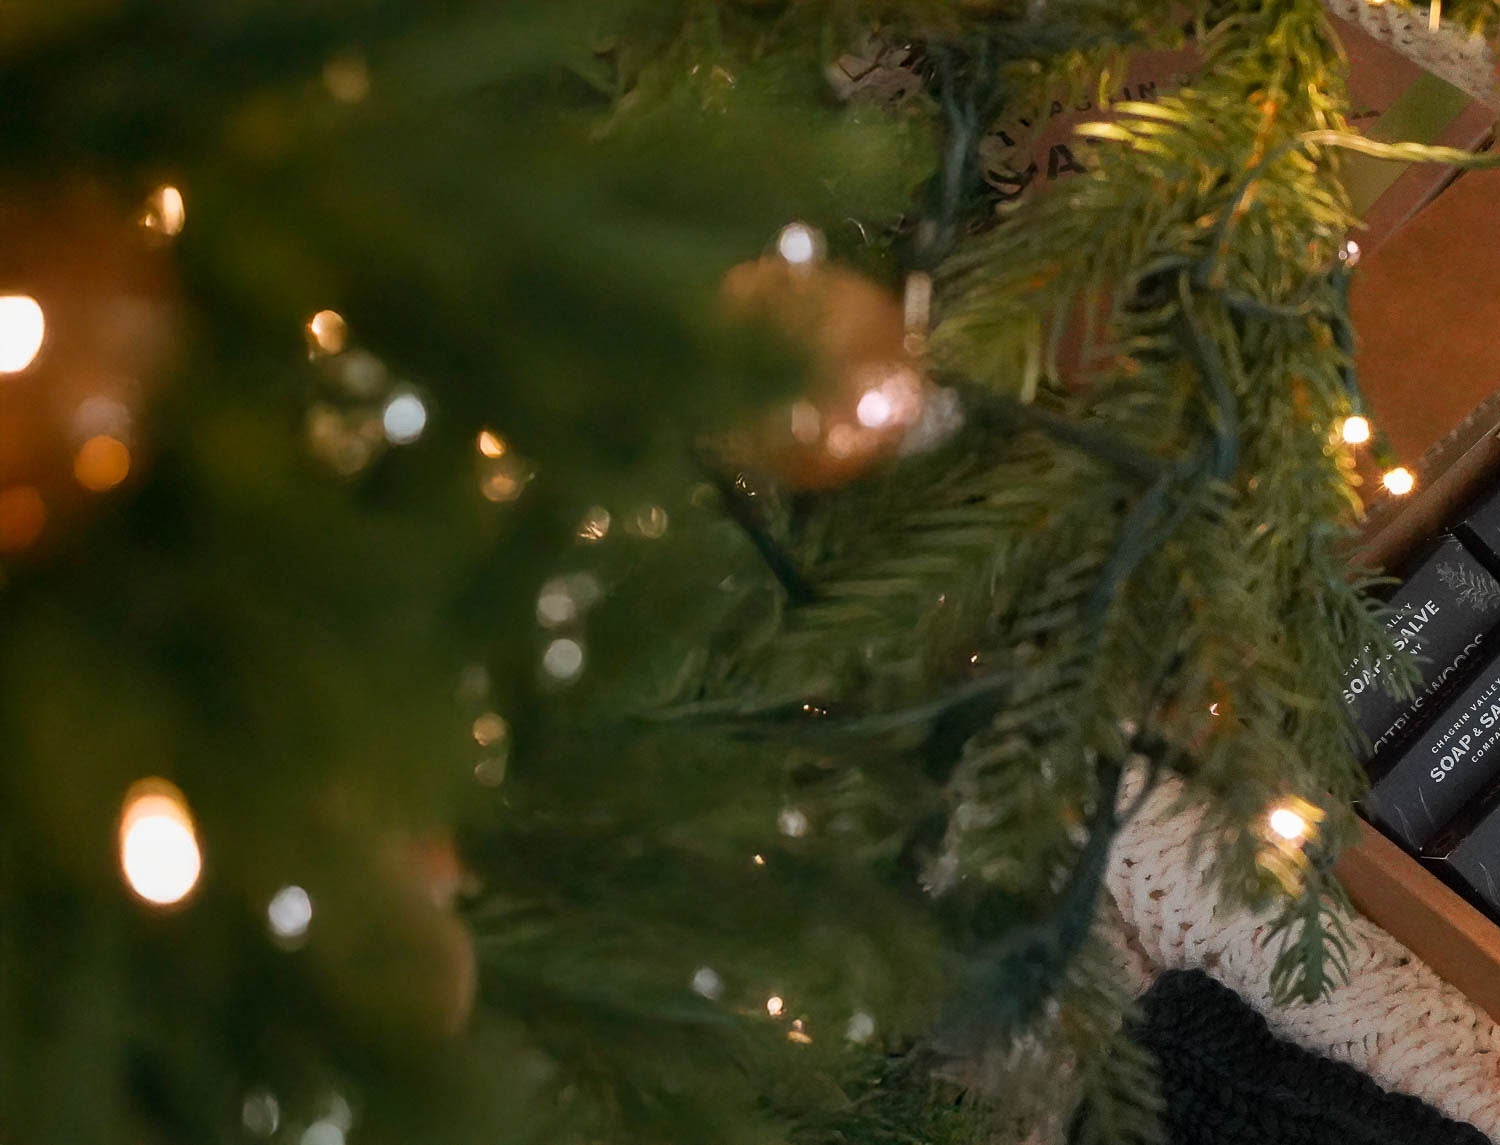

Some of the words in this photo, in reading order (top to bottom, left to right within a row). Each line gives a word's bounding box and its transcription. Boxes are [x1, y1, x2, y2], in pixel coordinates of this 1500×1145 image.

[1393, 600, 1440, 651] SALVE
[1430, 735, 1471, 783] SOAP
[1473, 727, 1483, 737] &
[1431, 713, 1470, 754] CHAGRIN
